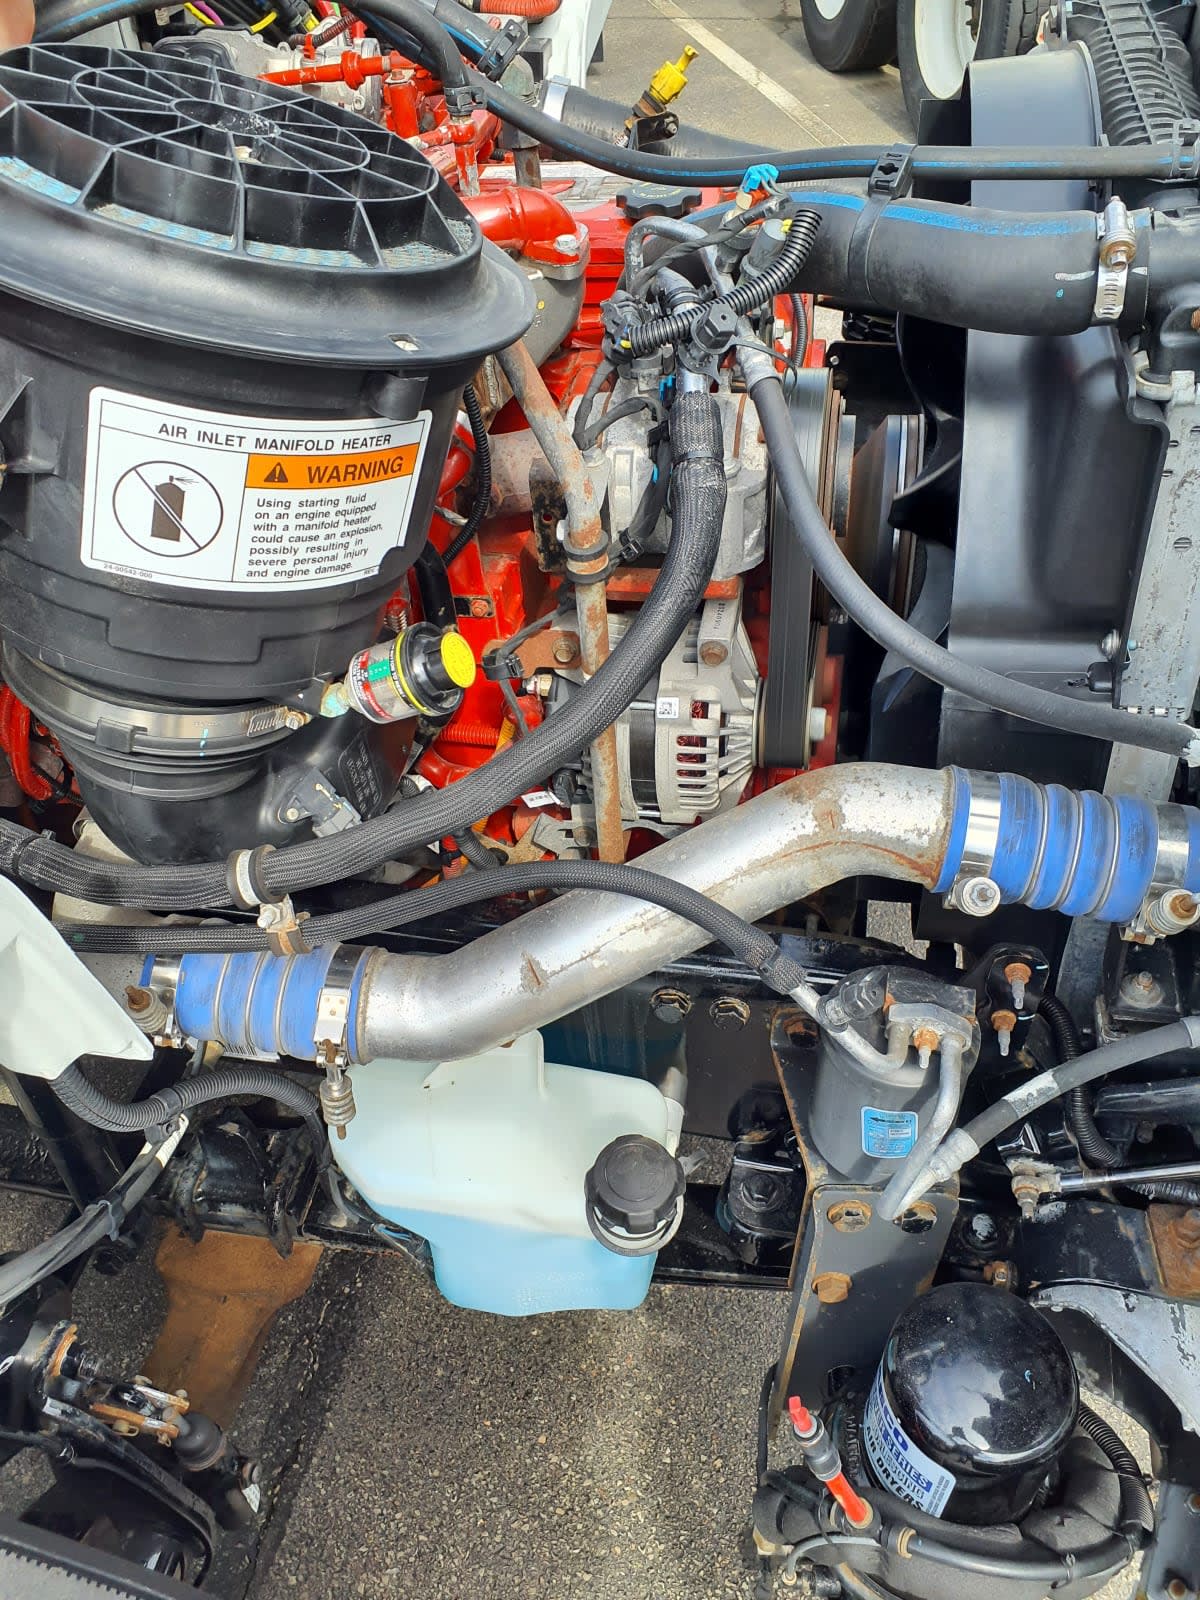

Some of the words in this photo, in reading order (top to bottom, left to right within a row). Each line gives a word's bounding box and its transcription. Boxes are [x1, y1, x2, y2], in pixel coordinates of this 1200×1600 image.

[158, 423, 187, 439] AIR
[197, 430, 246, 448] INLET
[254, 437, 334, 451] MANIFOLD
[342, 434, 392, 449] HEATER
[307, 456, 403, 484] WARNING
[257, 498, 291, 510] Using
[298, 498, 340, 510] starting
[345, 493, 367, 505] fluid
[254, 511, 269, 519] on
[275, 511, 289, 520] an
[295, 510, 330, 521] engine
[335, 502, 377, 517] equipped
[253, 522, 277, 531] with
[282, 523, 289, 531] a
[294, 520, 339, 531] manifold
[343, 515, 371, 527] heater
[251, 534, 283, 543] could
[288, 534, 319, 543] cause
[324, 532, 336, 540] an
[248, 558, 287, 566] severe
[293, 553, 338, 566] personal
[343, 548, 369, 559] injury
[249, 546, 299, 556] possibly
[305, 540, 350, 553] resulting
[246, 569, 268, 577] and
[273, 568, 310, 578] engine
[314, 561, 353, 574] damage.
[866, 1425, 877, 1454] AIR
[875, 1456, 925, 1511] DRYERS
[884, 1434, 930, 1488] SERIES
